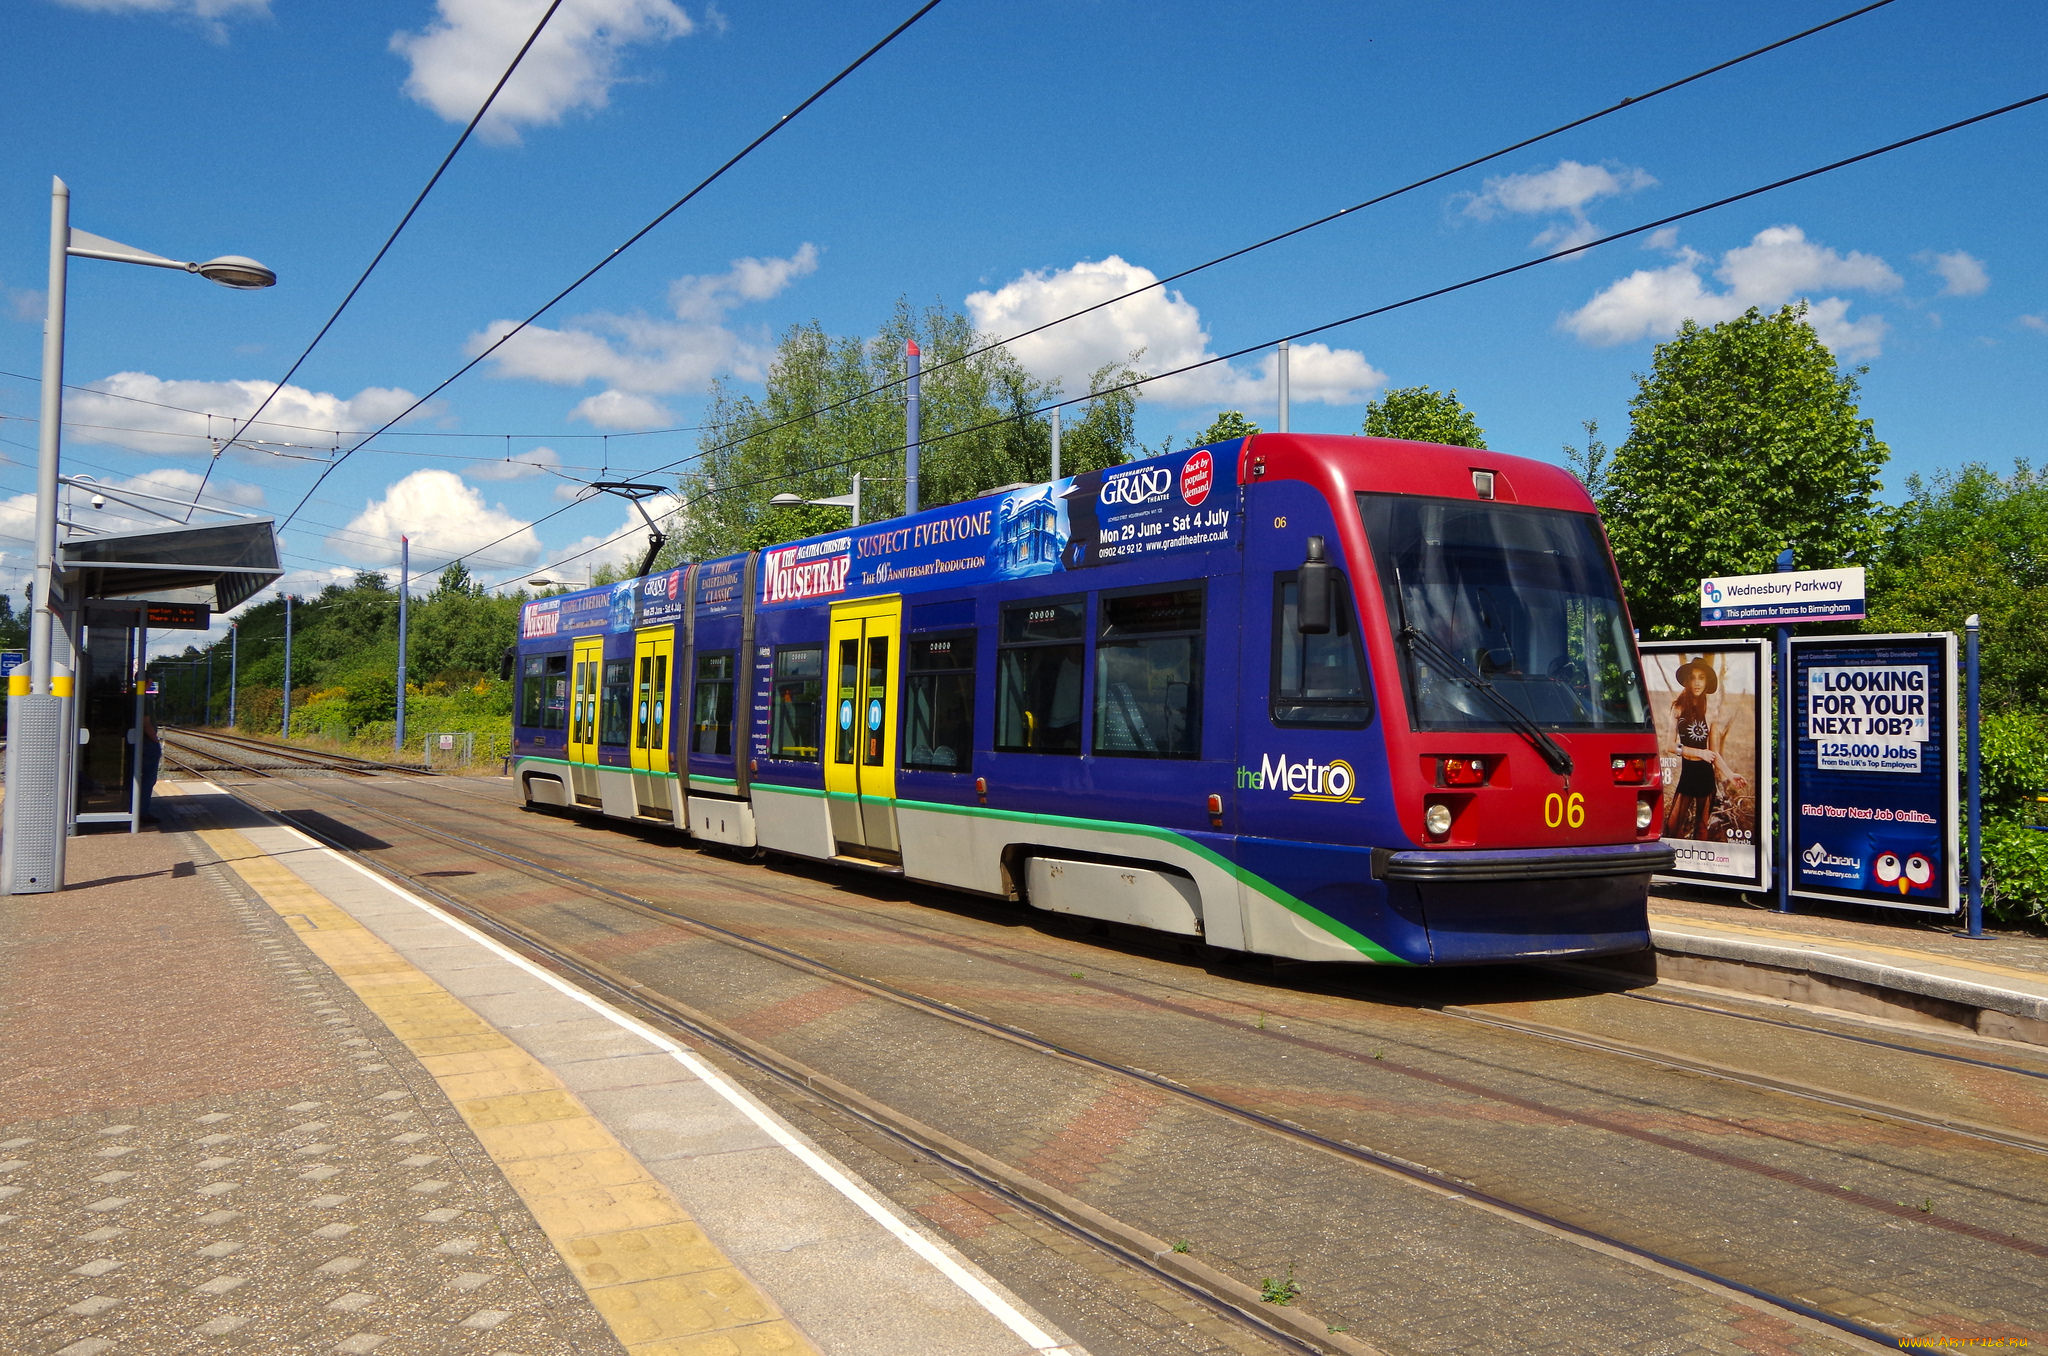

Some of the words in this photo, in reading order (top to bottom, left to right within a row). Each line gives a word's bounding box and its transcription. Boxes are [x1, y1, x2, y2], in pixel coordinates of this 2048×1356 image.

[1108, 465, 1155, 481] WOLVERHAMPTON
[1185, 460, 1200, 474] Back
[1200, 458, 1209, 469] by
[1100, 468, 1172, 505] GRAND
[1184, 470, 1208, 489] popular
[1147, 493, 1170, 503] THEATRE
[1184, 480, 1209, 498] demand
[1100, 528, 1119, 544] Mon
[1121, 524, 1135, 540] 29
[1137, 522, 1162, 538] June
[1172, 514, 1191, 532] Sat
[1193, 512, 1202, 528] 4
[1204, 508, 1230, 528] July
[1274, 516, 1288, 529] 06
[857, 528, 912, 560] SUSPECT
[914, 510, 993, 548] EVERYONE
[1098, 547, 1117, 558] 01902
[1117, 545, 1126, 555] 42
[1126, 544, 1135, 554] 92
[1135, 542, 1143, 552] 12
[1145, 529, 1229, 551] www.grandtheatre.co.uk
[796, 543, 821, 560] AGATHA
[820, 536, 852, 555] CHRISTIE'S
[782, 548, 798, 568] THE
[763, 552, 851, 602] MOUSETRAP
[887, 563, 935, 581] ANNIVERSARY
[935, 555, 987, 574] PRODUCTION
[1727, 582, 1791, 597] Wednesbury
[1795, 579, 1843, 593] Parkway
[1727, 609, 1740, 618] This
[1740, 607, 1767, 619] platform
[1768, 607, 1778, 616] for
[1779, 606, 1799, 615] Trams
[1800, 606, 1808, 614] to
[1808, 604, 1851, 616] Birmingham
[1812, 695, 1856, 715] FOR
[1861, 694, 1925, 716] YOUR
[1812, 718, 1862, 735] NEXT
[1821, 743, 1880, 759] 125,000
[1882, 744, 1918, 760] Jobs
[1821, 759, 1838, 767] from
[1838, 759, 1849, 767] the
[1851, 759, 1867, 768] UK's
[1868, 760, 1880, 769] Top
[1880, 761, 1918, 770] Employers
[1544, 792, 1585, 829] 06
[1802, 804, 1824, 816] Find
[1825, 805, 1847, 818] Your
[1848, 807, 1873, 819] Next
[1874, 808, 1893, 820] Job
[1675, 845, 1730, 863] oohoo.com
[1803, 868, 1860, 880] www.cv-library.co.uk
